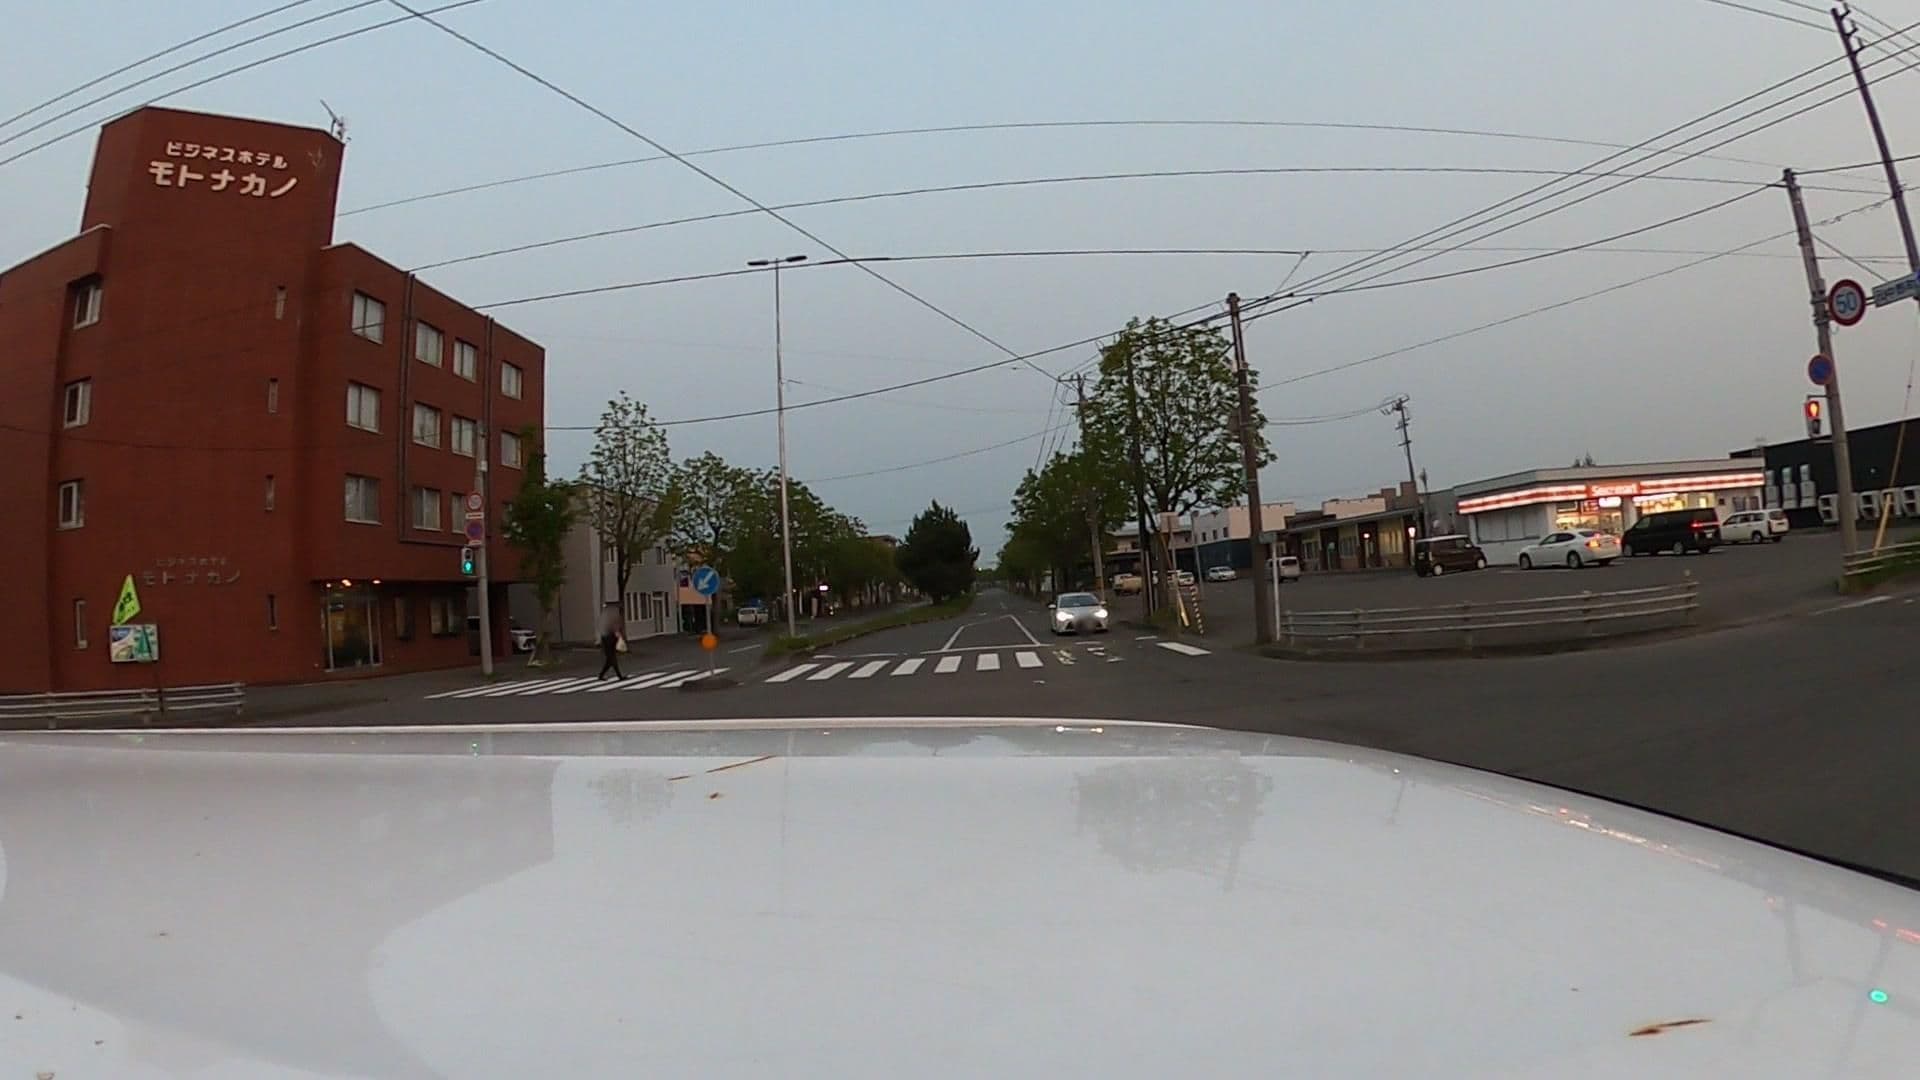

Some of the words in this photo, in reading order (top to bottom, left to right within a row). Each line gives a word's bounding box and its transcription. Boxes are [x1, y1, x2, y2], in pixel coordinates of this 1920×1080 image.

[166, 142, 288, 168] ビジネスホテル
[148, 161, 298, 196] モトナカノ
[1837, 291, 1857, 313] 50
